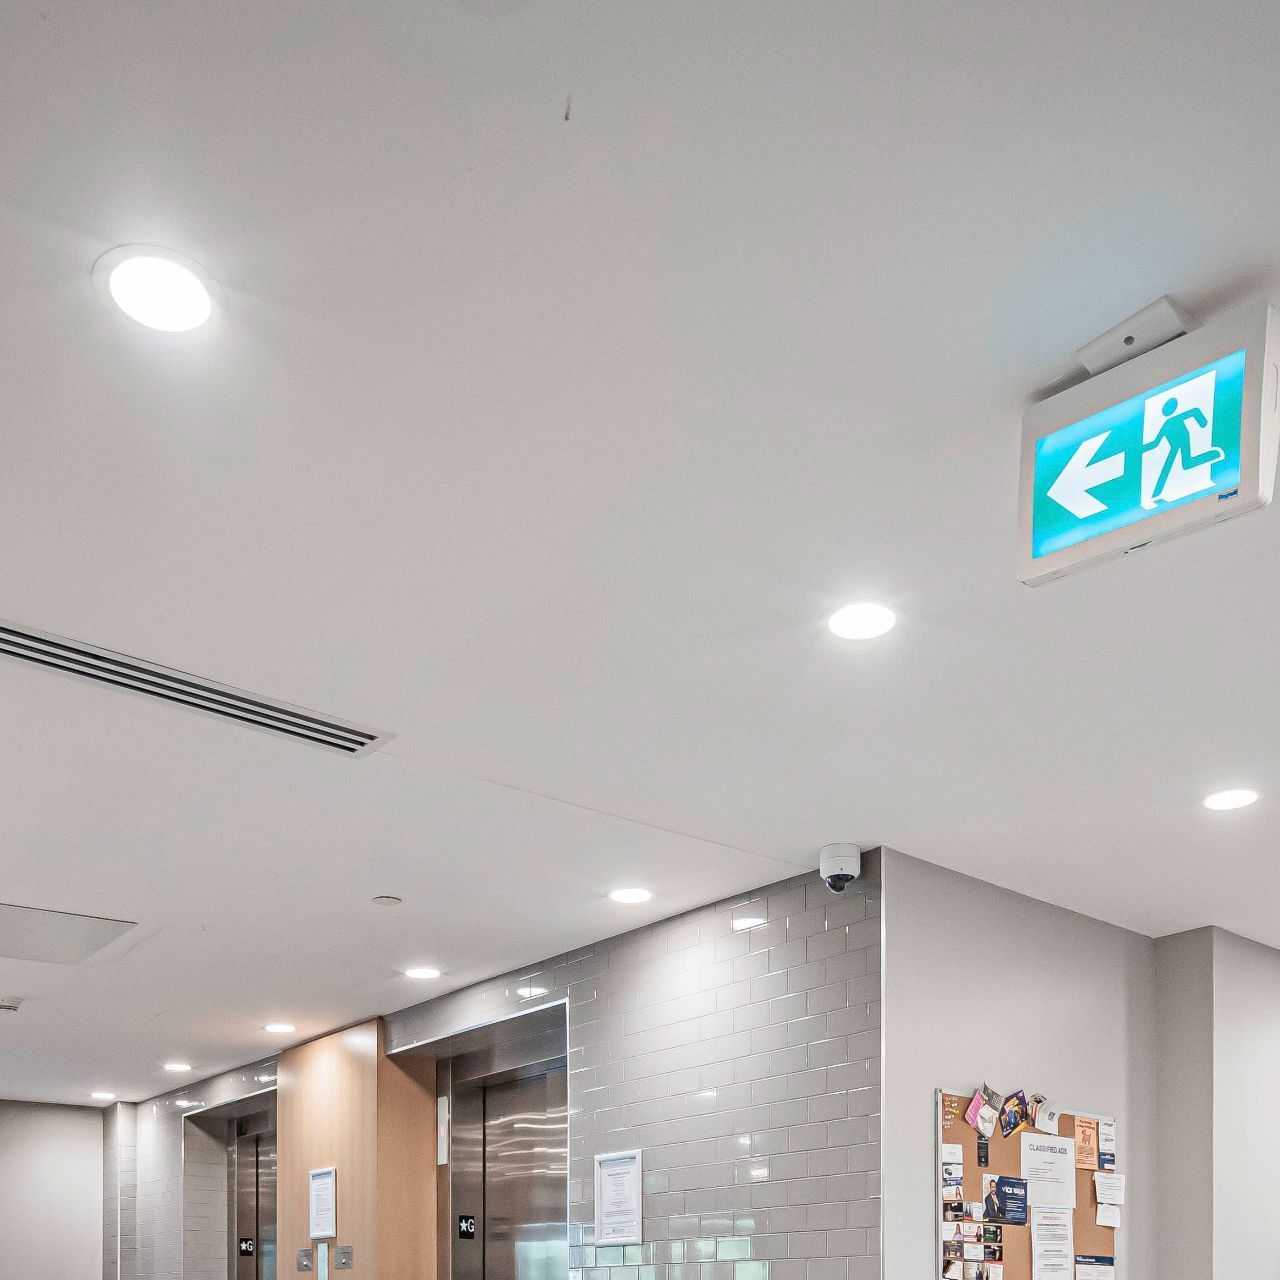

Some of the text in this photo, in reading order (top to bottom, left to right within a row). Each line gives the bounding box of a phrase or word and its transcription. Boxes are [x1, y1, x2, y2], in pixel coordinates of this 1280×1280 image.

[1029, 1143, 1068, 1155] CLASSIFIED ADS
[468, 1219, 475, 1232] G
